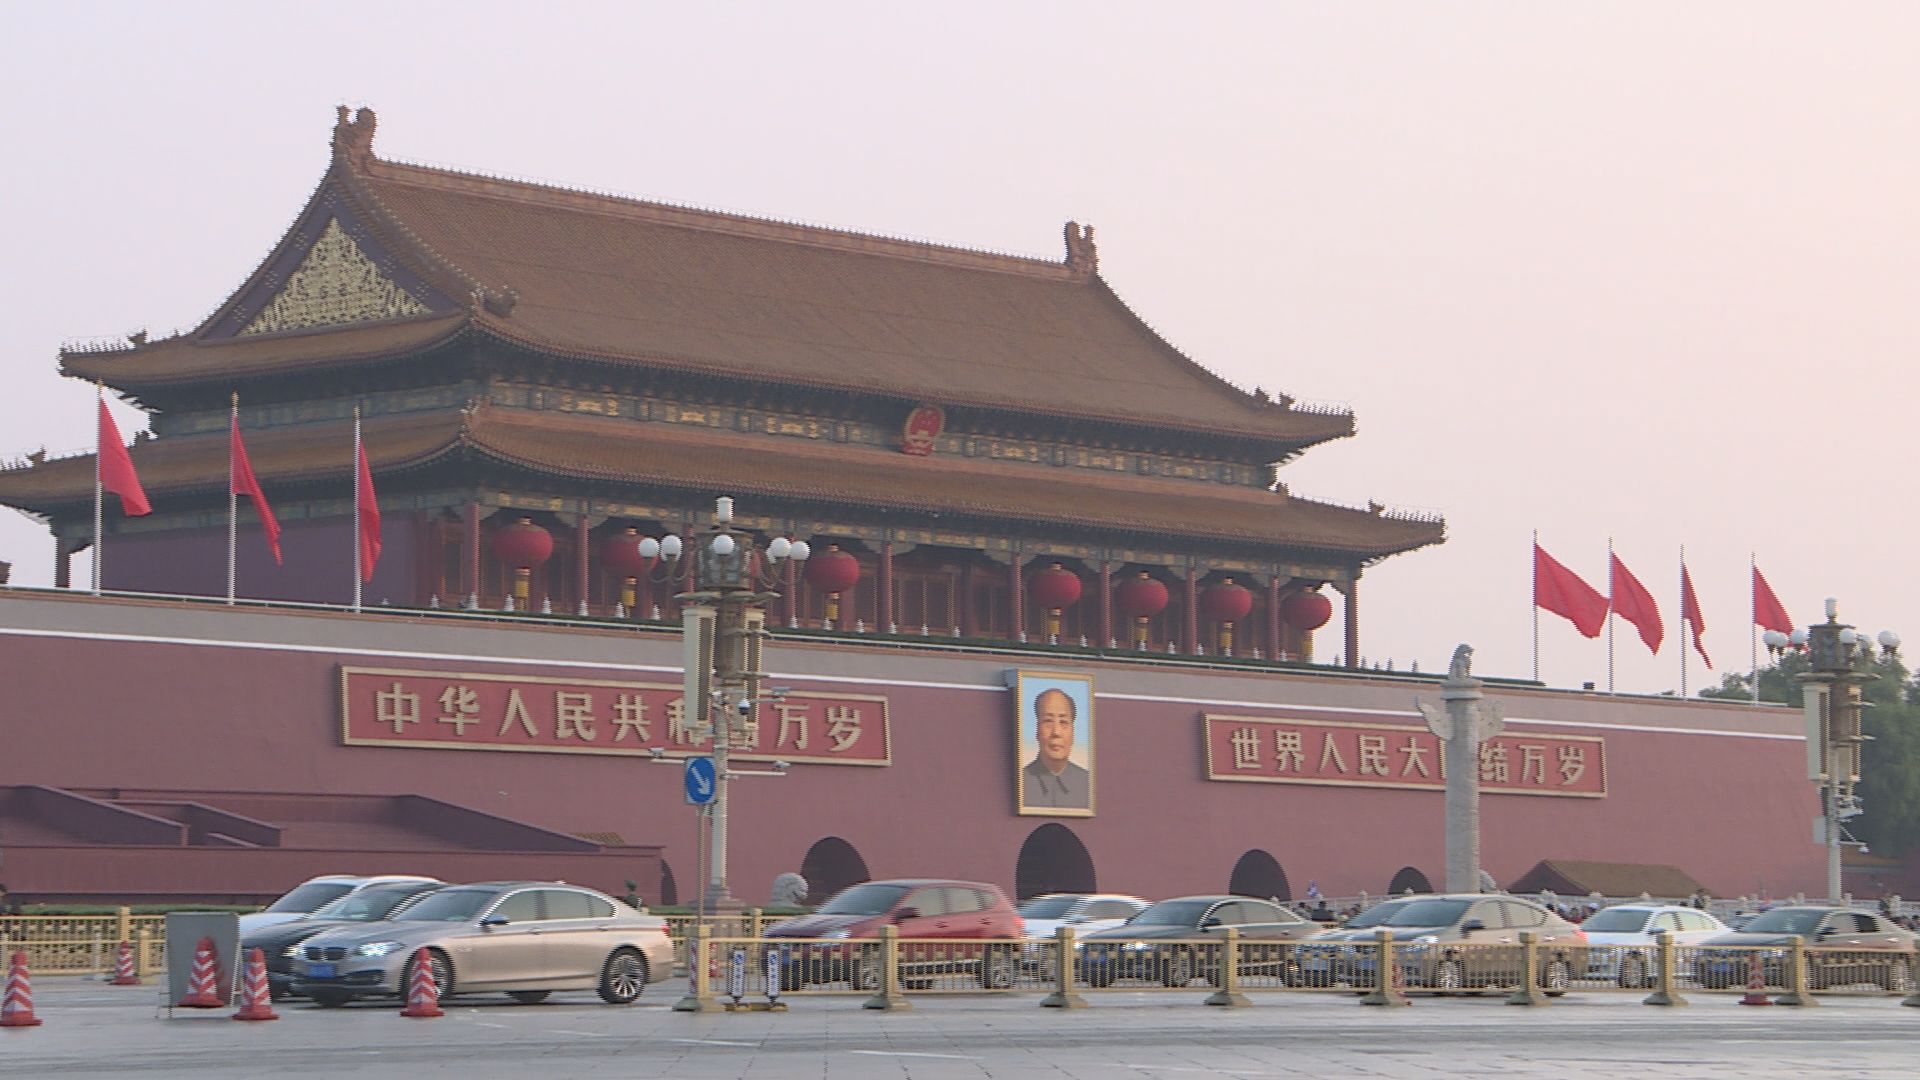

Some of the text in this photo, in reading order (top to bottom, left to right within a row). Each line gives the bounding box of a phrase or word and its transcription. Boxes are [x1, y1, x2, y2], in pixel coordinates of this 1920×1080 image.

[375, 682, 862, 752] 中华人民共和万岁
[1231, 727, 1585, 785] 世界人民大结万岁
